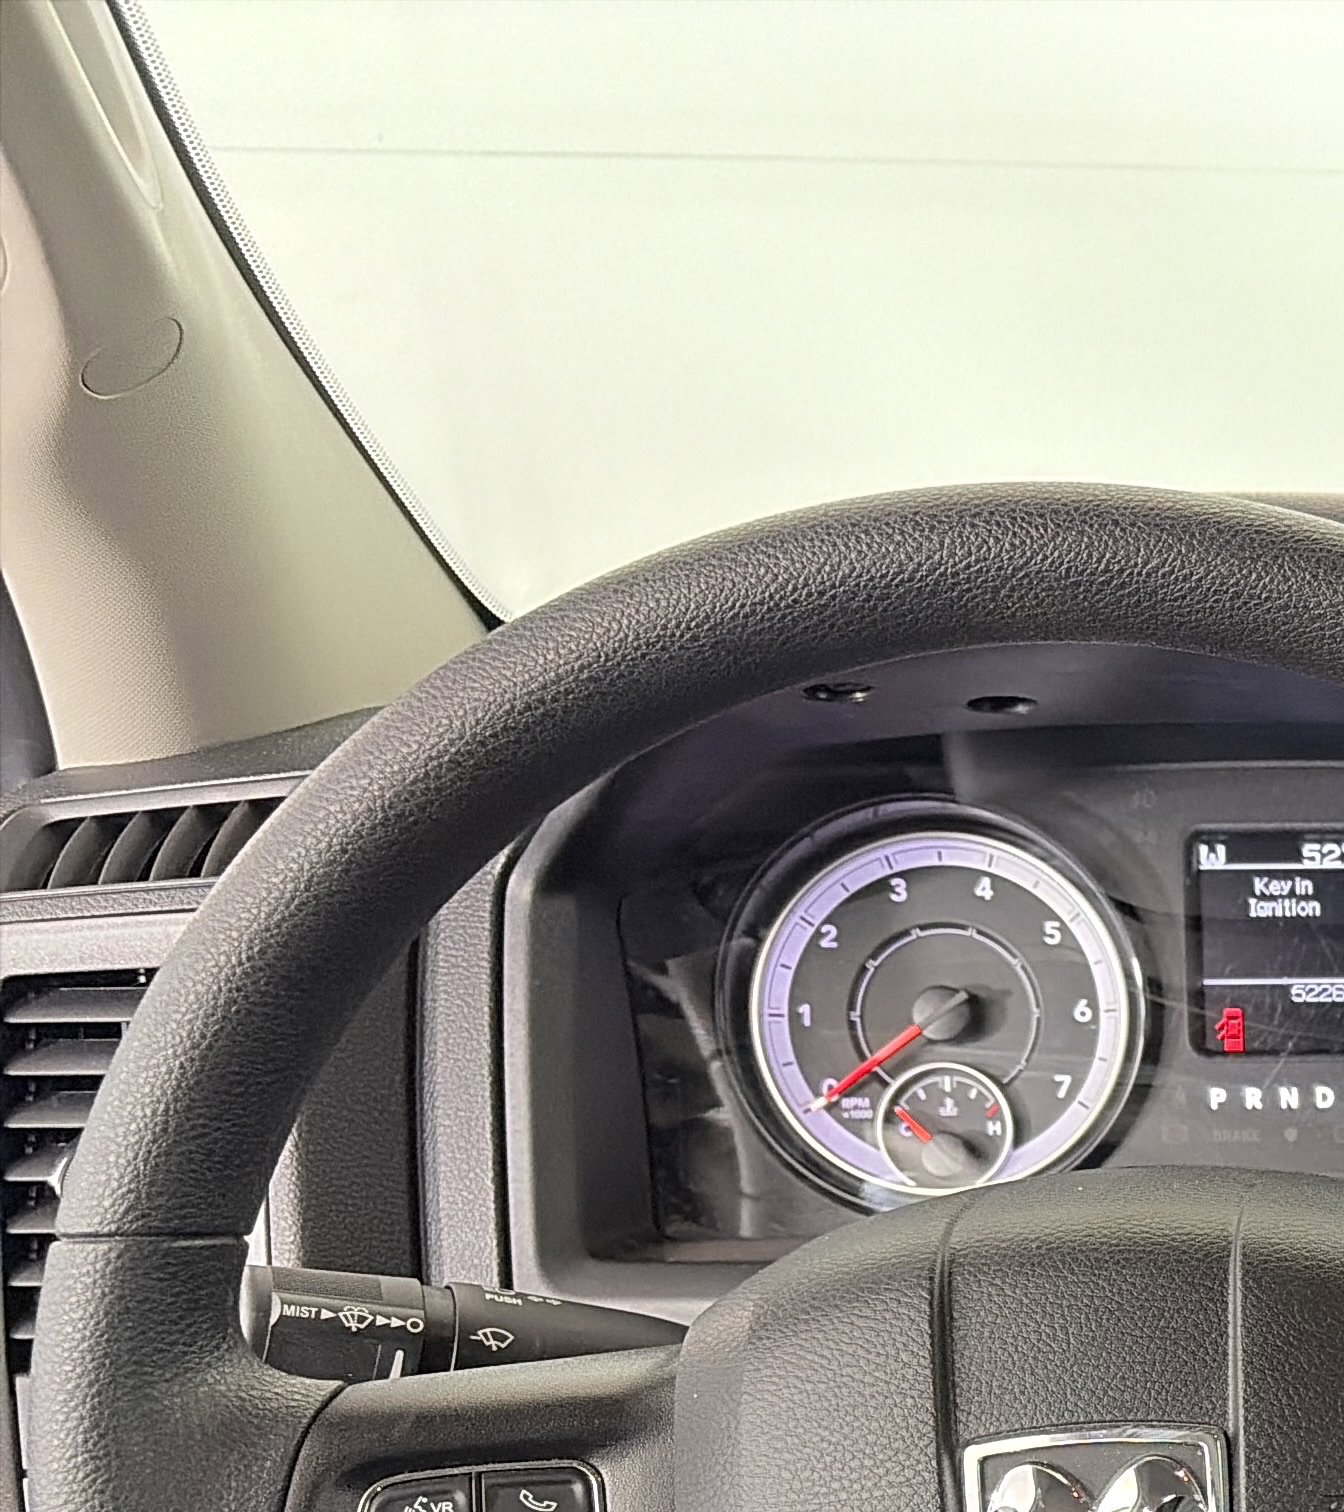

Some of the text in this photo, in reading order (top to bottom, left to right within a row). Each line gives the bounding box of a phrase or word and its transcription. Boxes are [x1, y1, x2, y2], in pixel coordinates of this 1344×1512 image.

[1199, 843, 1226, 866] W
[888, 878, 908, 903] 3
[973, 876, 993, 901] 4
[1253, 876, 1314, 896] Key in
[1248, 898, 1321, 918] Ignition
[818, 924, 839, 949] 2
[1043, 921, 1061, 945] 5
[797, 1003, 812, 1026] 1
[1073, 999, 1093, 1023] 6
[1053, 1075, 1072, 1098] 7
[1208, 1085, 1335, 1110] P R N D
[841, 1097, 871, 1109] RPM
[986, 1120, 1001, 1136] H
[485, 1293, 523, 1306] PUSH
[282, 1304, 319, 1319] MIST
